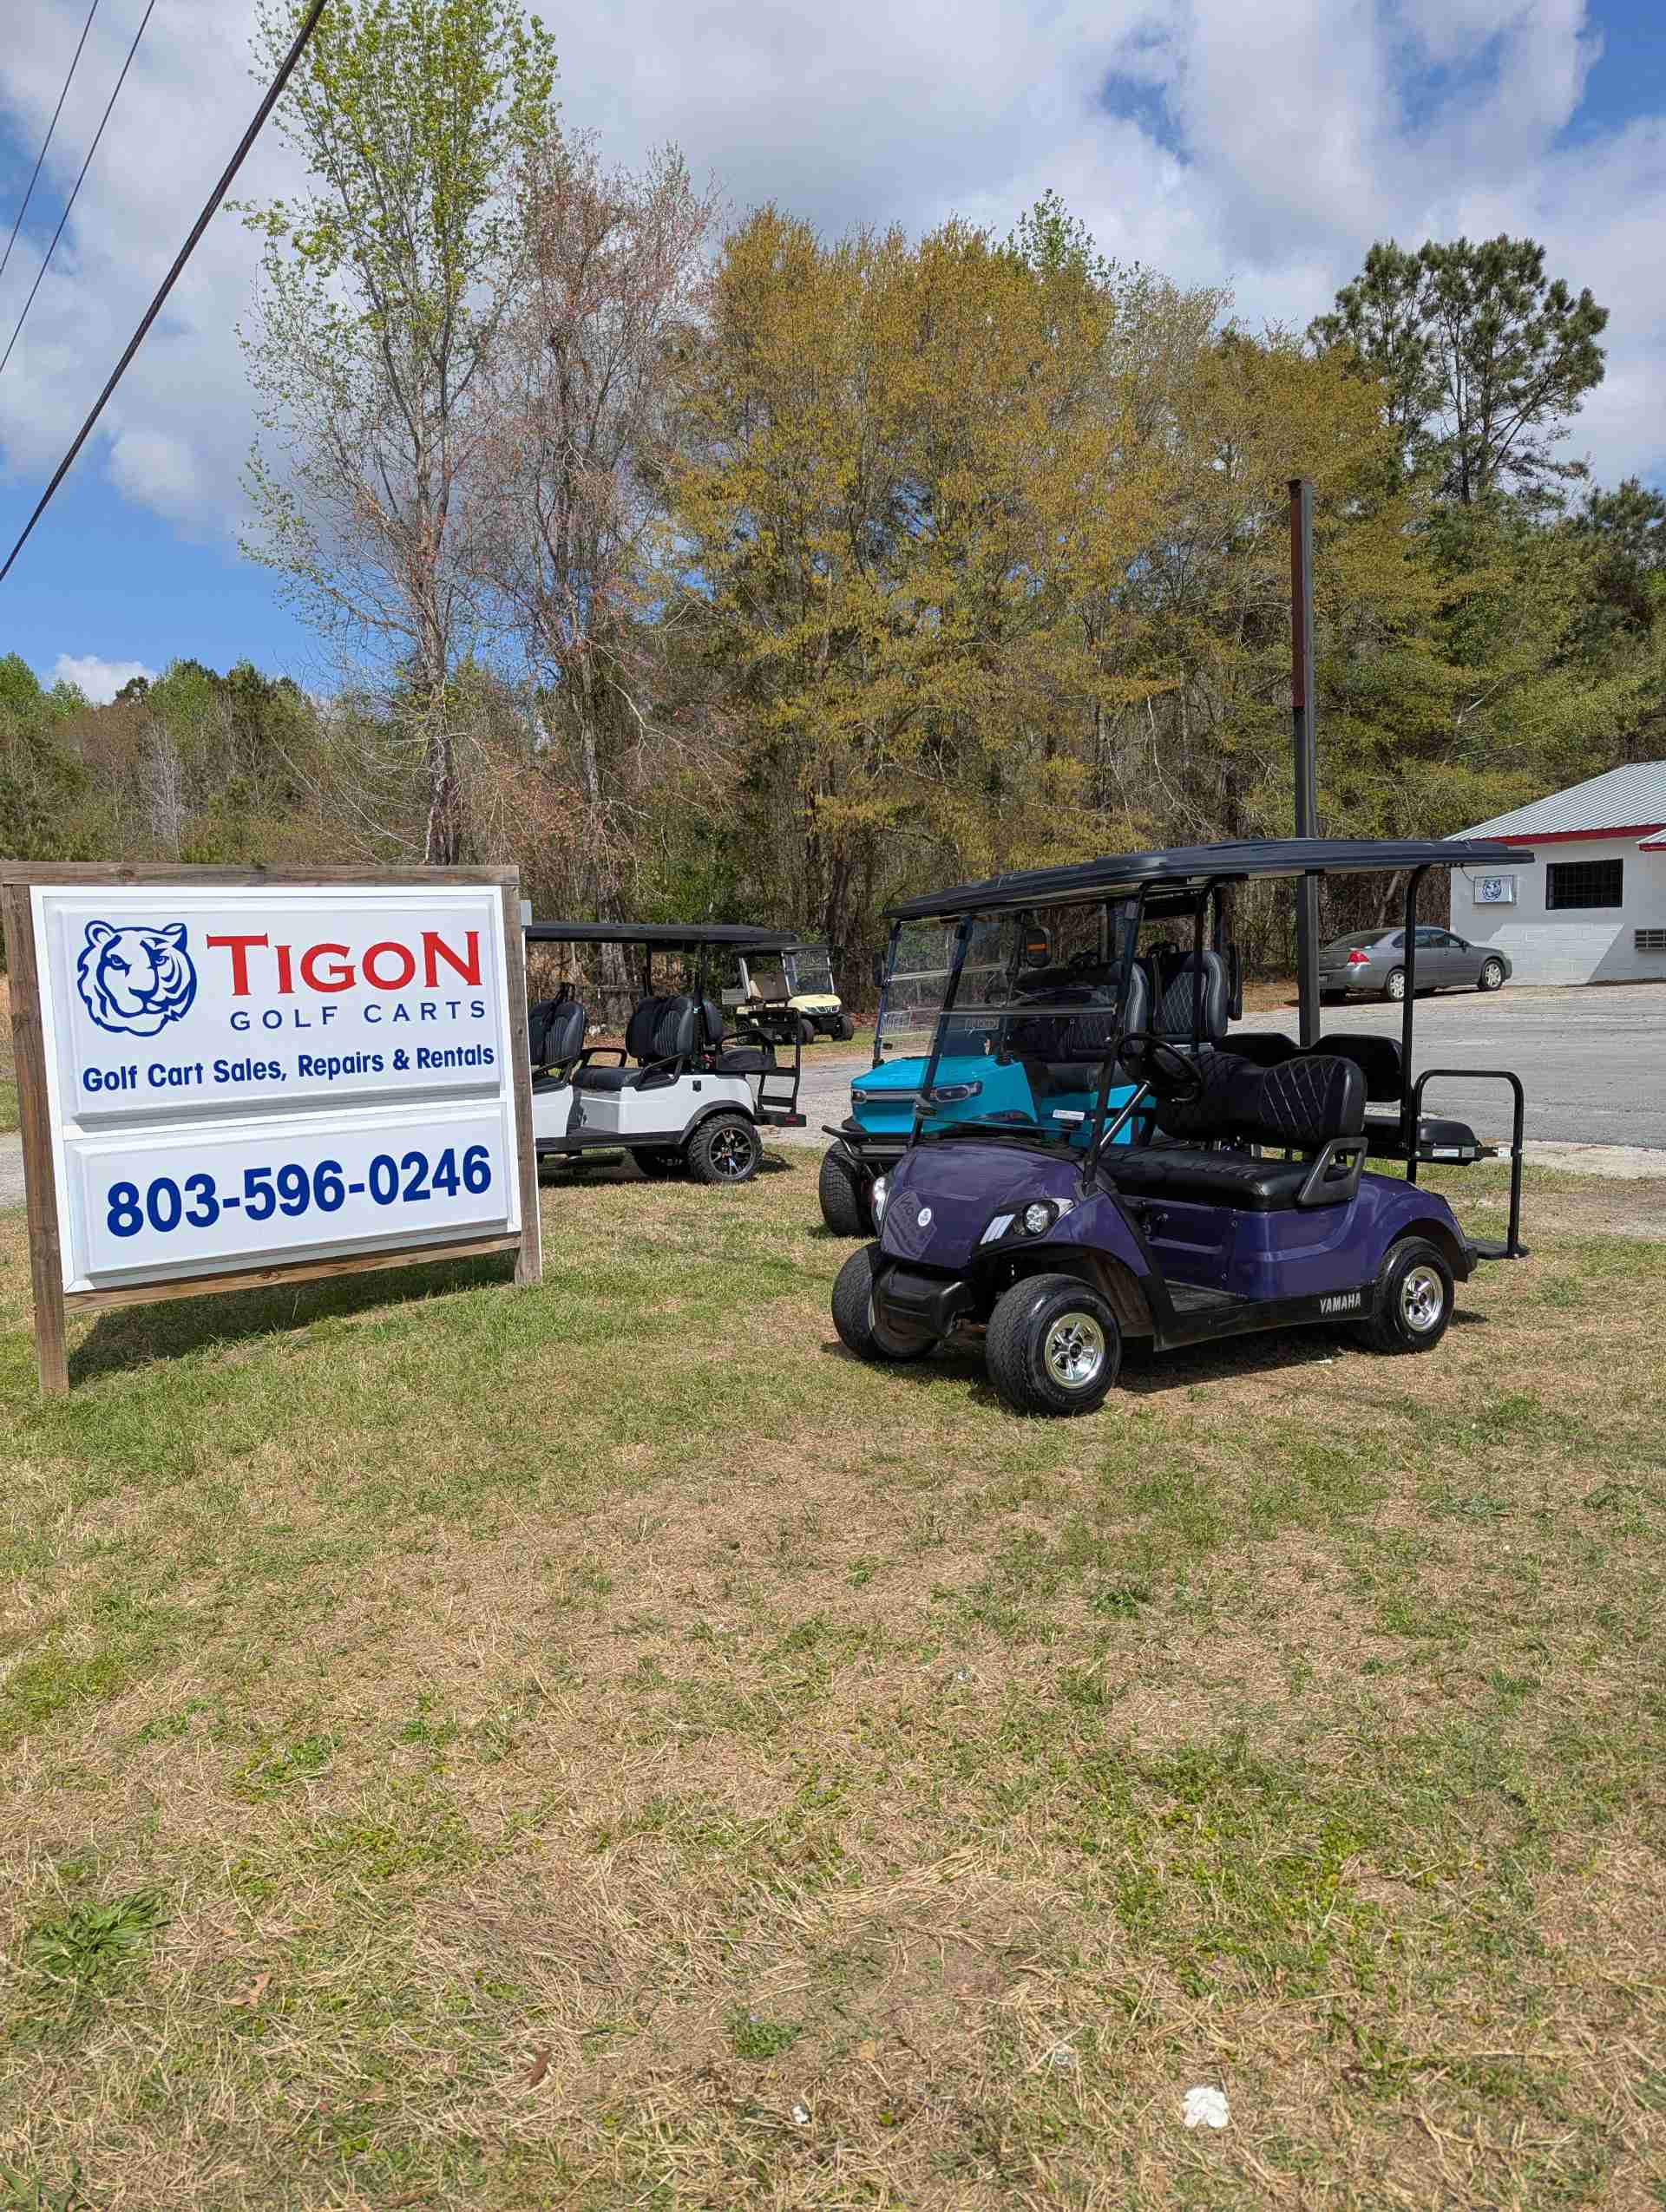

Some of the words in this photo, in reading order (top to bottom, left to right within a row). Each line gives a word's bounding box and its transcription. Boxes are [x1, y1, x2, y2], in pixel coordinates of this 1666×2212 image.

[207, 932, 483, 995] TIGON
[230, 1005, 338, 1032] GOLF
[363, 1000, 486, 1025] CARTS
[82, 1064, 138, 1092] Golf
[147, 1063, 204, 1089] Cart
[213, 1057, 288, 1083] Sales,
[298, 1052, 384, 1082] Repairs
[393, 1048, 410, 1070] &
[416, 1045, 495, 1070] Rentals
[107, 1145, 492, 1237] 803-596-0246
[1320, 1292, 1361, 1314] YAMAHA
